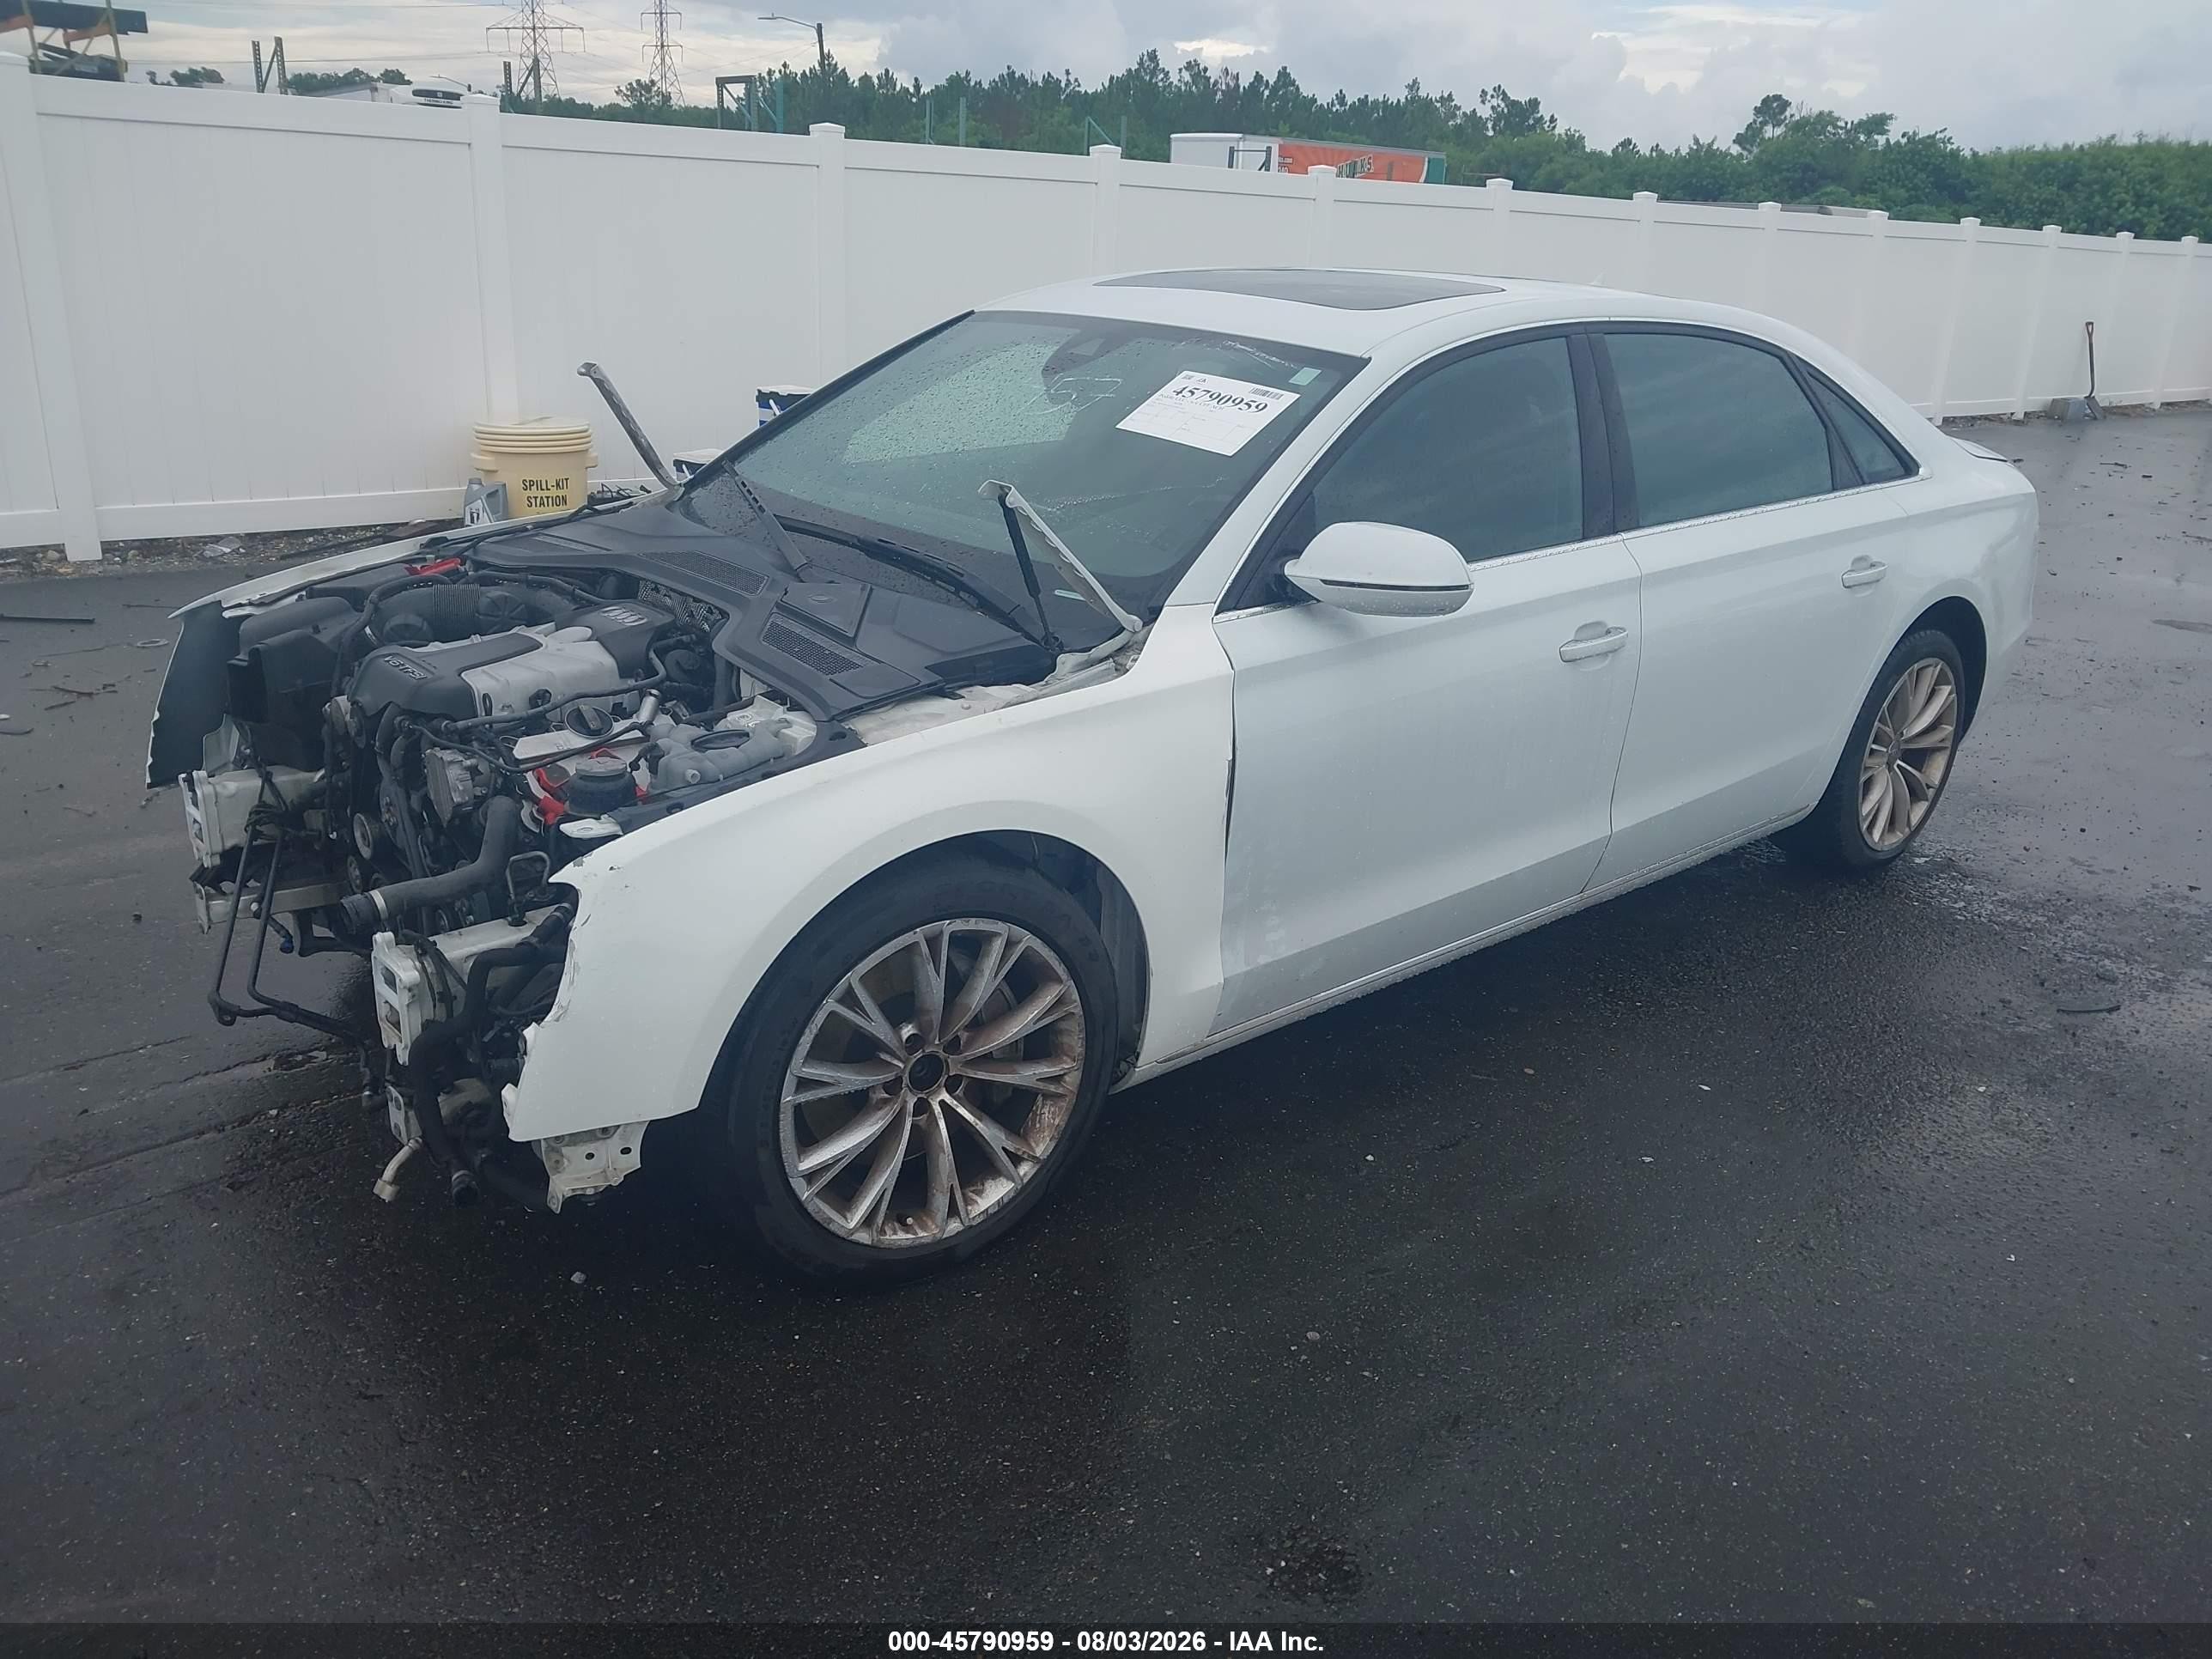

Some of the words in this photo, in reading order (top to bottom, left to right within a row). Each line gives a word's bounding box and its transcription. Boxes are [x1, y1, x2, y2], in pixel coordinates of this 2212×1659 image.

[1172, 385, 1268, 414] 45790959
[521, 477, 570, 492] SPILL-KIT
[526, 494, 568, 508] STATION
[384, 655, 404, 666] V6
[399, 665, 427, 679] TFSI
